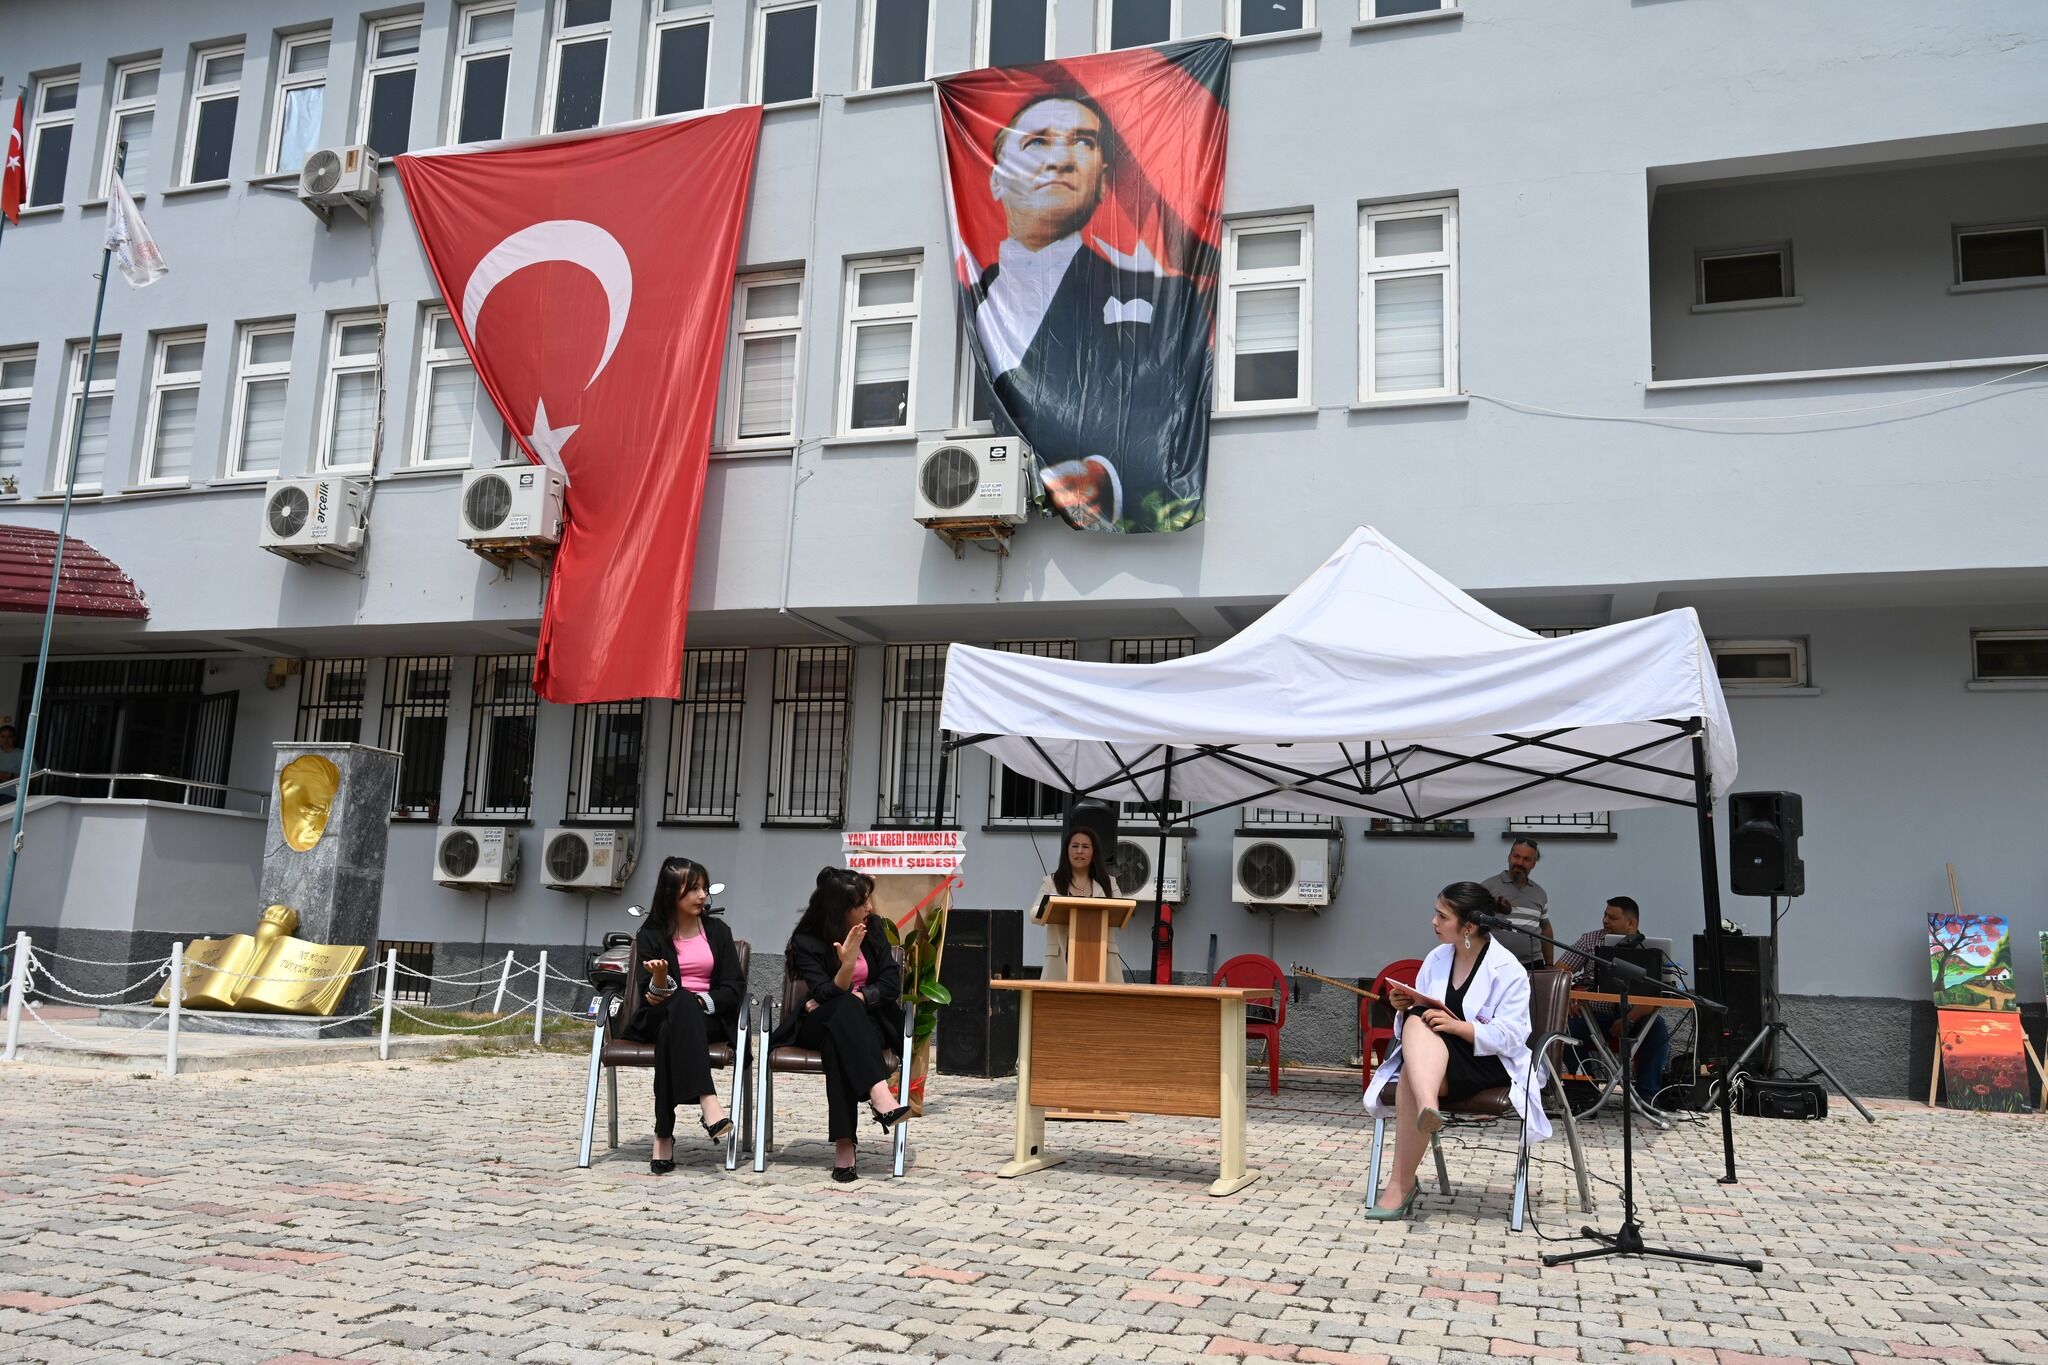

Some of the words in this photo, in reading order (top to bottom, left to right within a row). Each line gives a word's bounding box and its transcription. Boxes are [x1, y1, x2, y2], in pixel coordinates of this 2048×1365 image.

[317, 481, 329, 523] arçelik
[848, 833, 867, 846] YAPI
[869, 833, 878, 846] VE
[880, 831, 904, 846] KREDİ
[907, 832, 942, 846] BANKASI
[944, 832, 957, 848] A.Ş
[849, 856, 903, 868] KADİRLİ
[907, 856, 957, 869] ŞUBESİ
